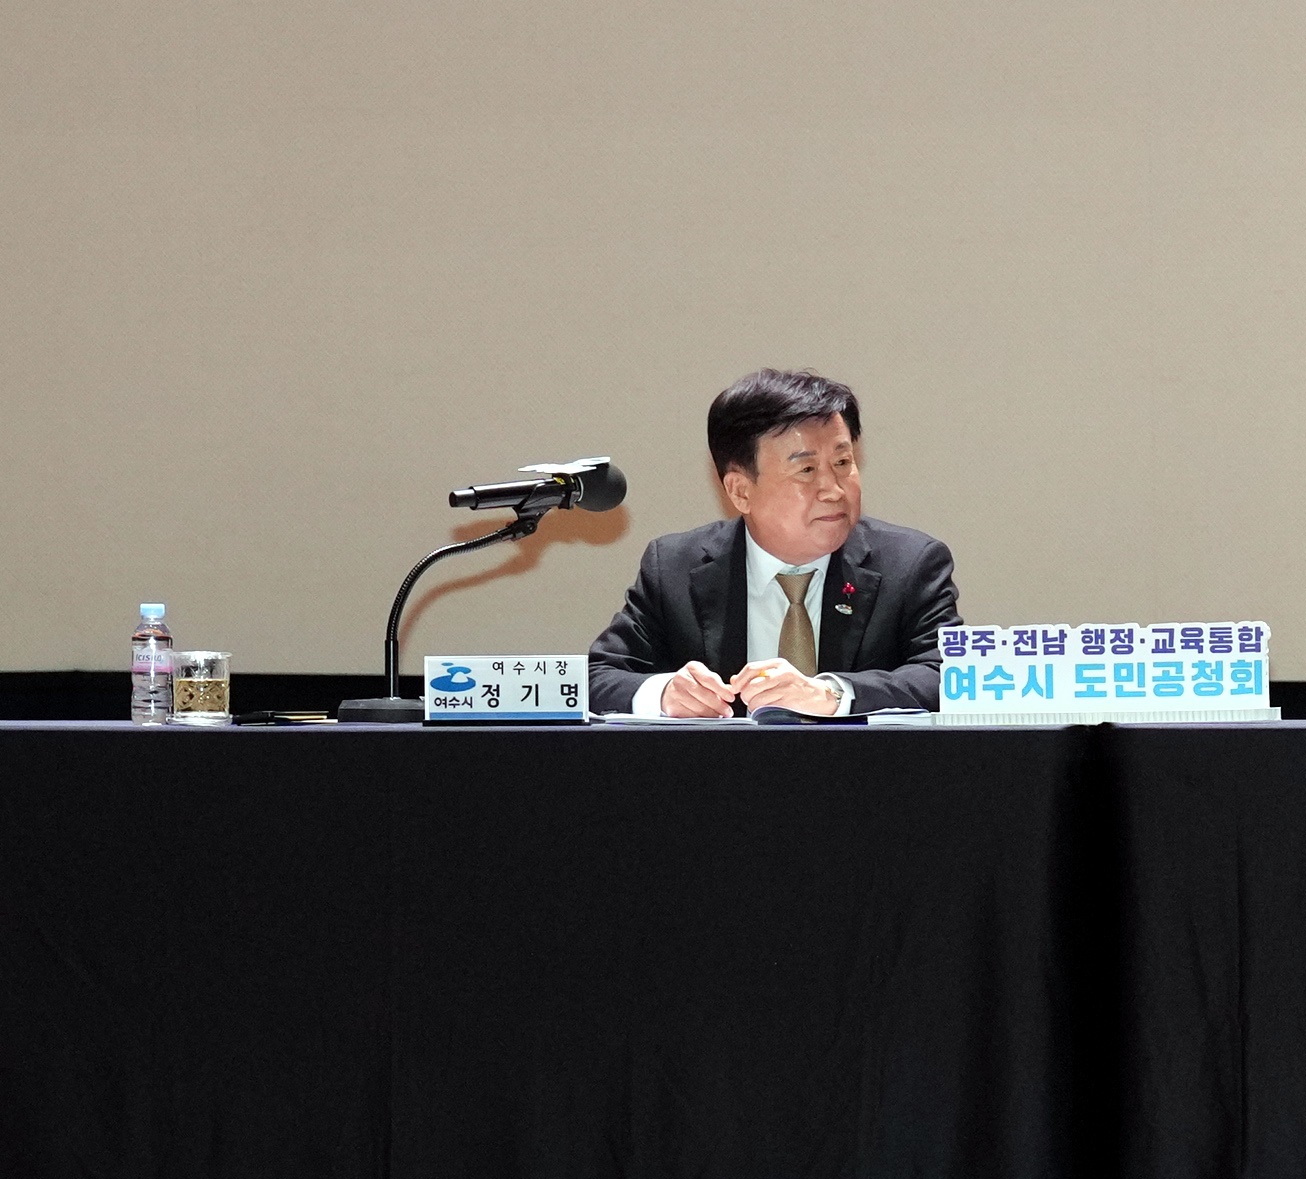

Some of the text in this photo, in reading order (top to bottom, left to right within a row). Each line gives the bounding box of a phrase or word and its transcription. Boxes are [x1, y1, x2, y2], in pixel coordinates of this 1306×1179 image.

[941, 626, 1265, 657] 광주·전남 행정·교육통합
[944, 659, 1264, 701] 여수시 도민공청회
[434, 696, 474, 709] 여수시
